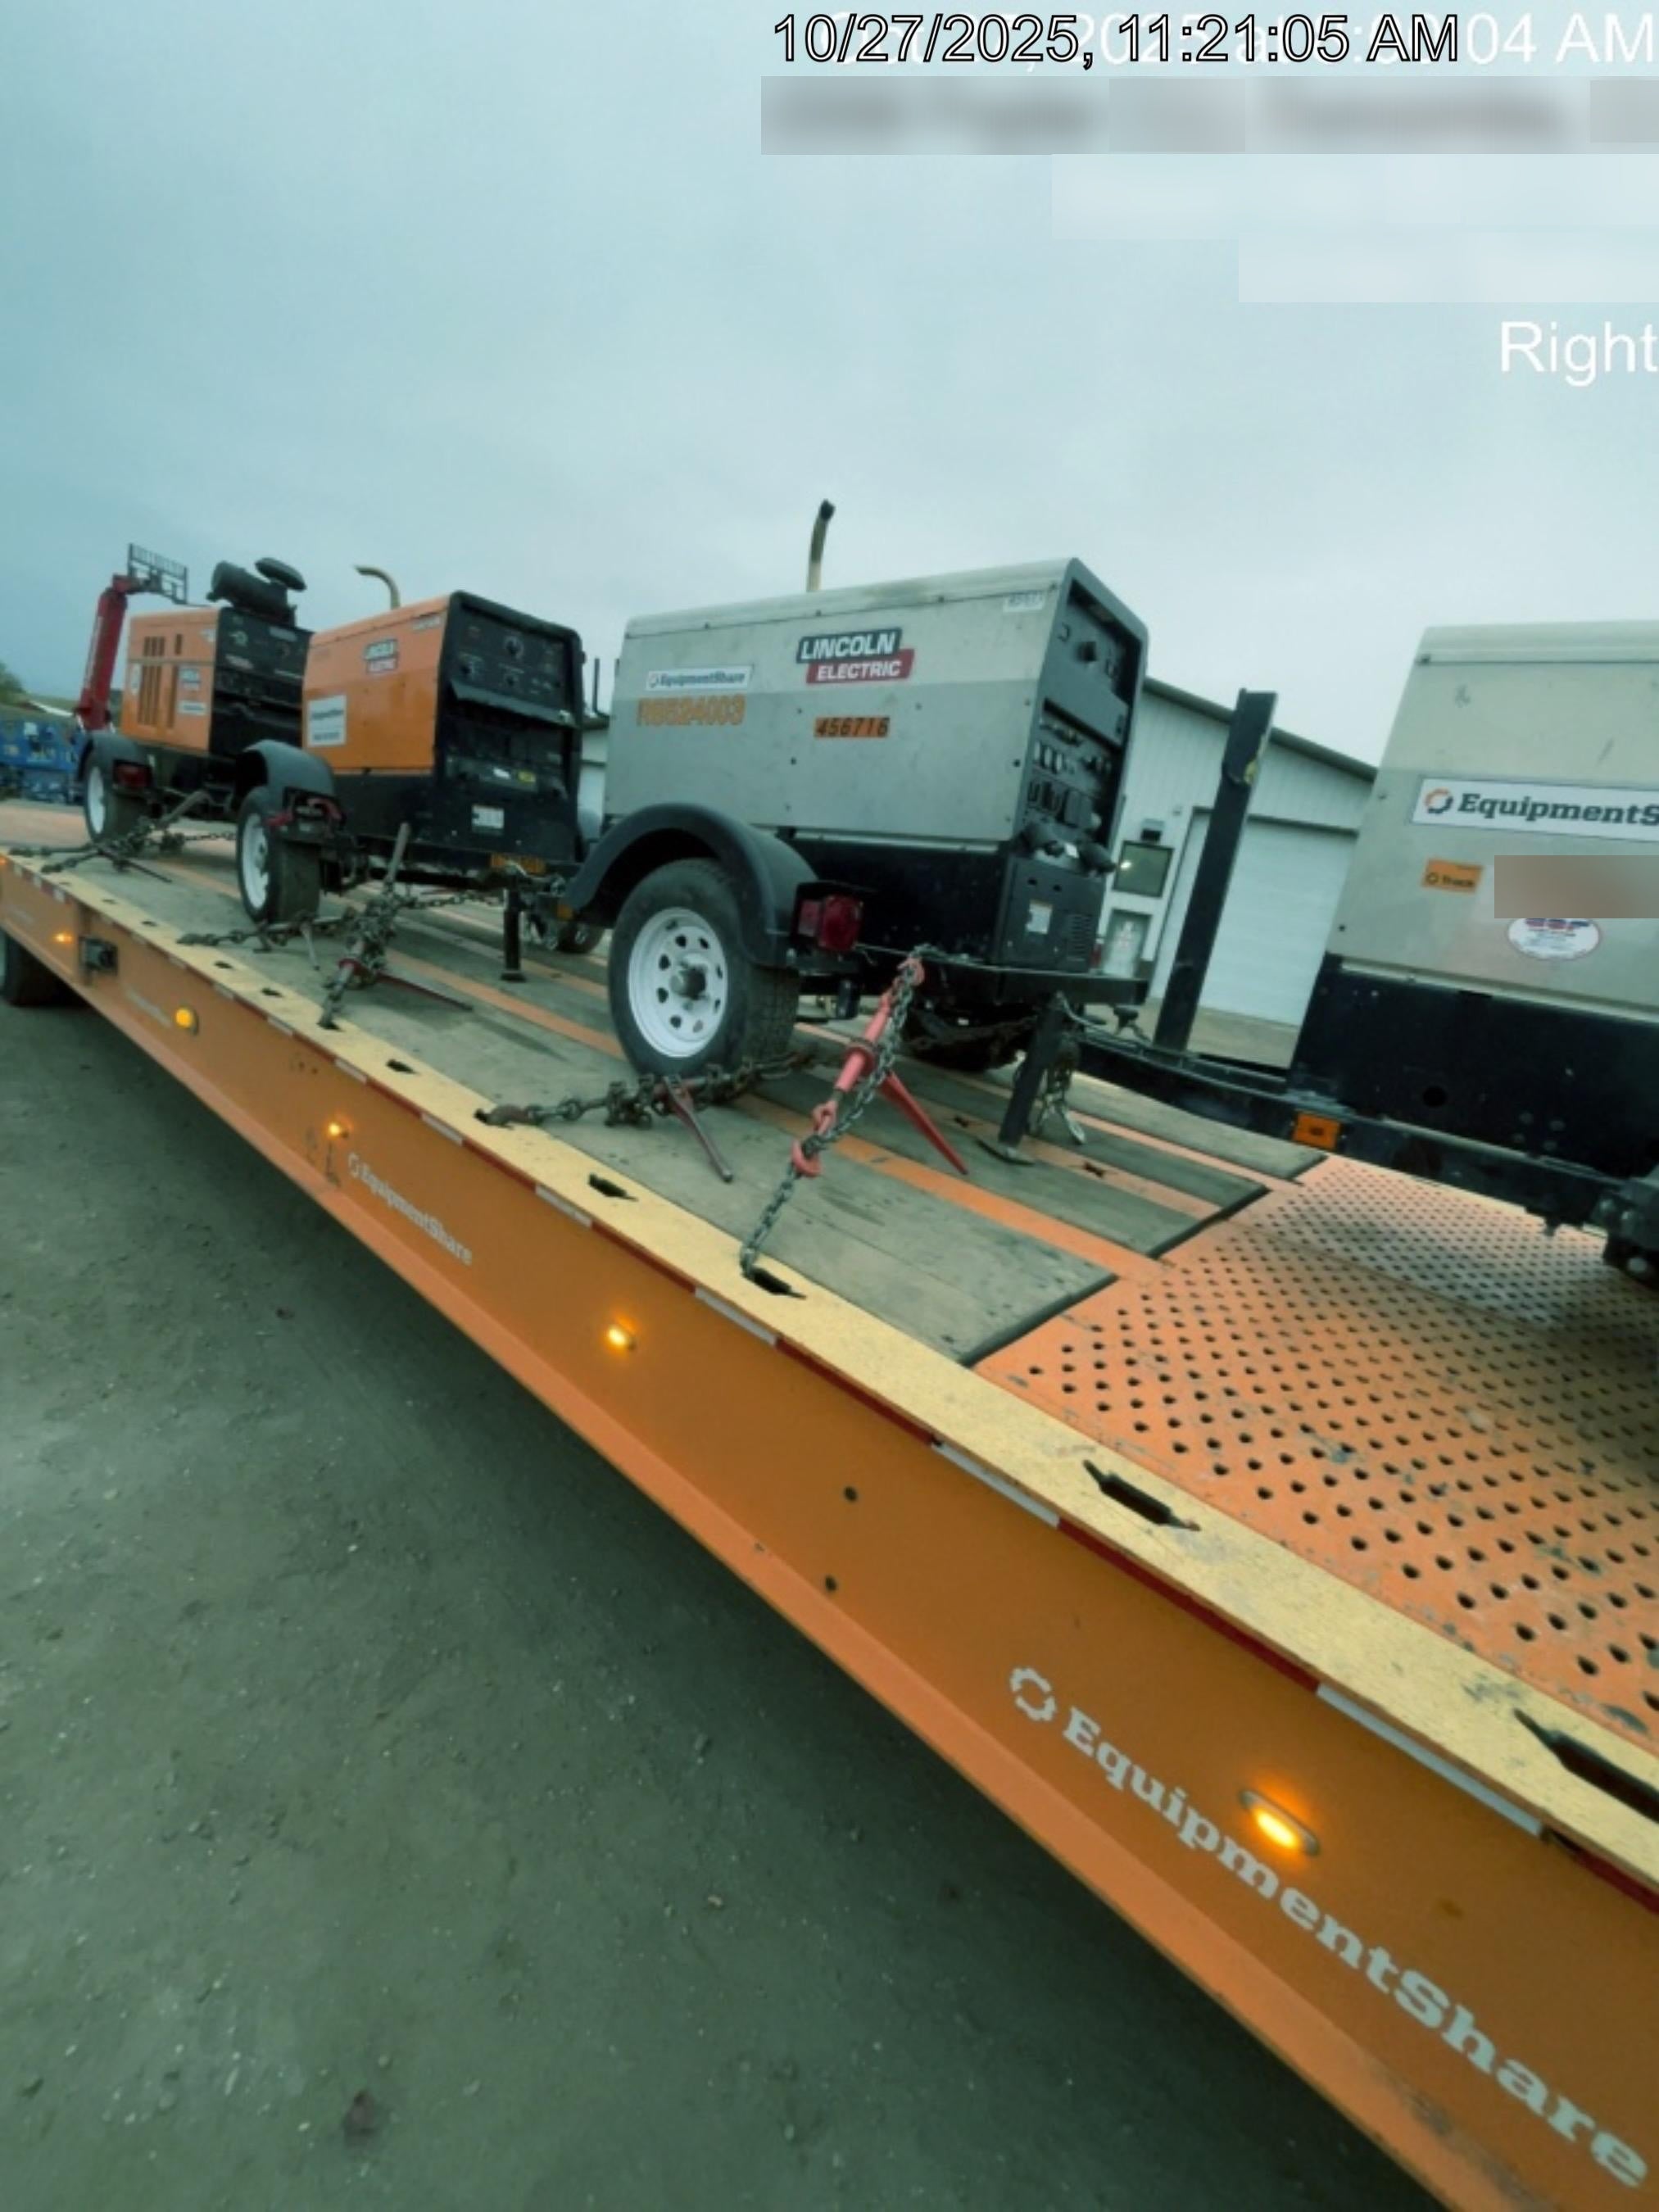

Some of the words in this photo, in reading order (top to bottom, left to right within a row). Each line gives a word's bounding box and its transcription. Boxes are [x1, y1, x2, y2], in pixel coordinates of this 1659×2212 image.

[800, 632, 897, 660] LINCOLN
[660, 670, 746, 687] EquipmentShare
[817, 660, 902, 682] ELECTRIC
[1063, 1705, 1648, 2188] EquipmentShare
